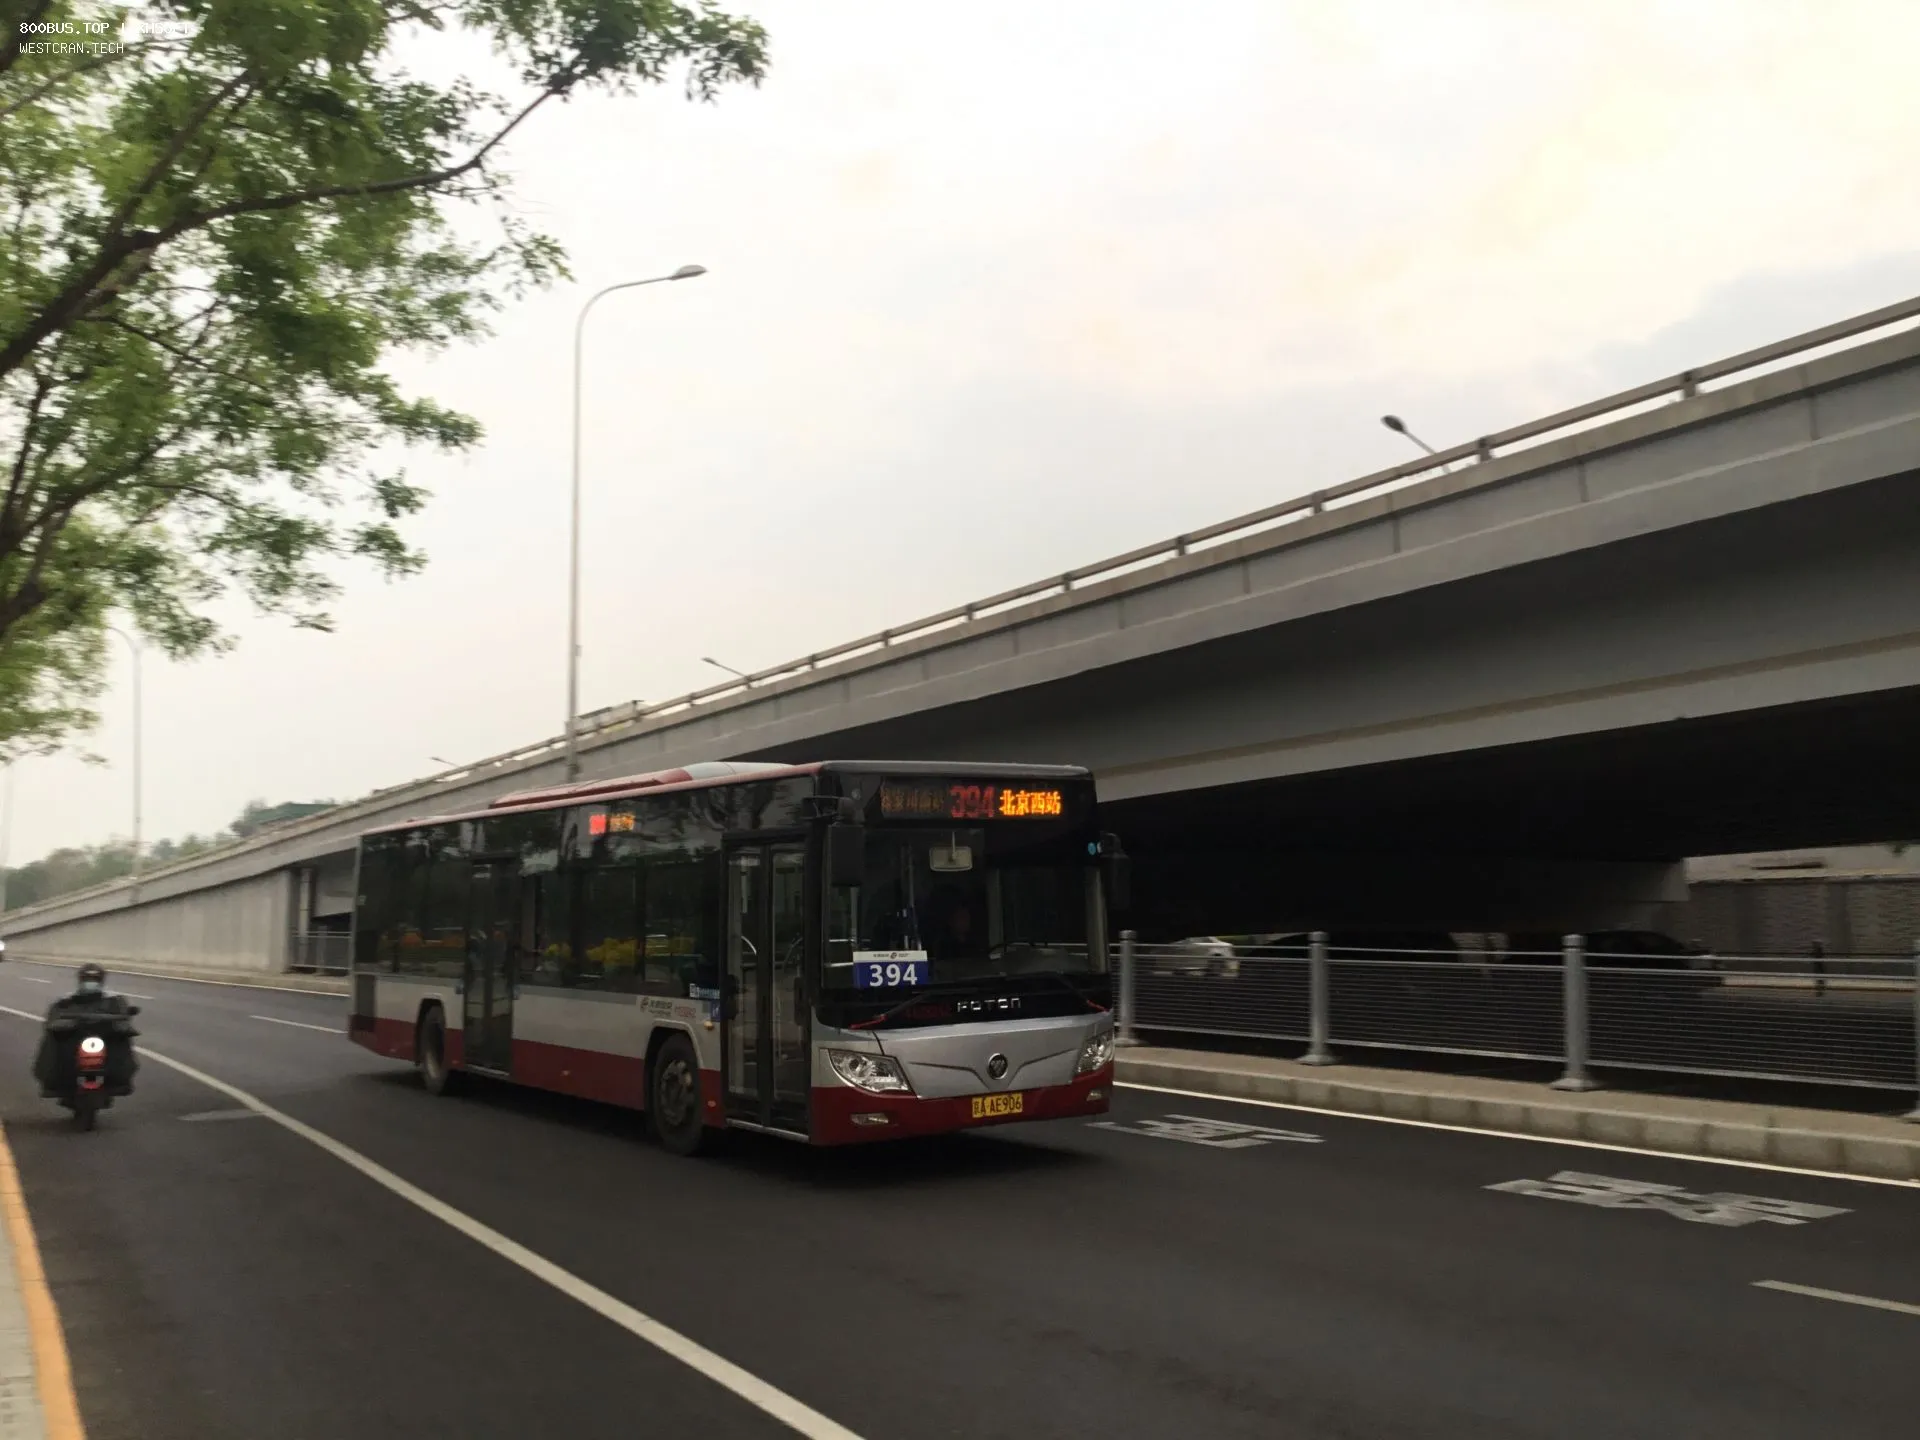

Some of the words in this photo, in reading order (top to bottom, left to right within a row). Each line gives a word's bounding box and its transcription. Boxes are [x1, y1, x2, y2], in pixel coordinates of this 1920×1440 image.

[951, 785, 995, 818] 394
[999, 788, 1062, 817] 北京西站
[869, 963, 918, 987] 394
[957, 998, 1021, 1013] FOTON
